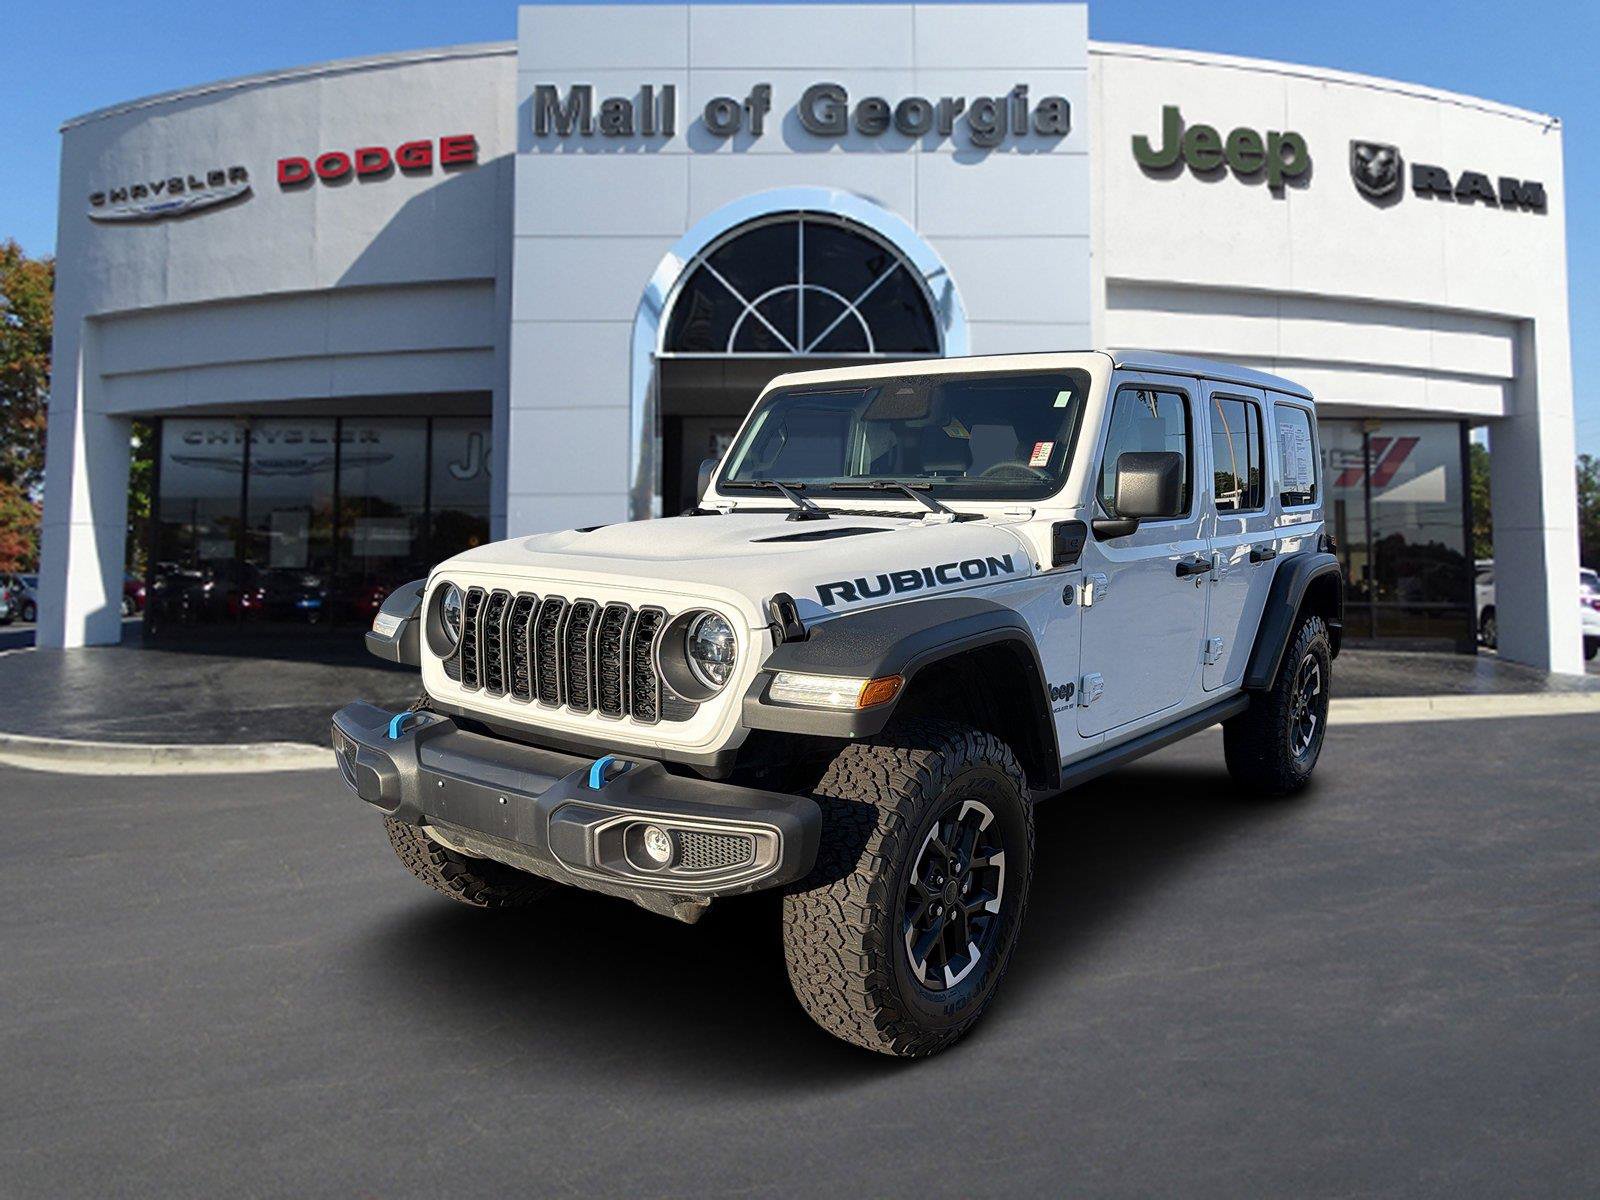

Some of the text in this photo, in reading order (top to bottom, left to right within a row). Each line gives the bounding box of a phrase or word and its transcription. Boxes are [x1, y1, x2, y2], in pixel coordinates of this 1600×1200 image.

[533, 82, 1072, 149] Mall of Georgia
[276, 134, 476, 186] DODGE
[1131, 105, 1308, 190] Jeep
[88, 166, 249, 206] CHRYSLER
[1411, 162, 1547, 211] RAM
[815, 554, 1015, 607] RUBICON
